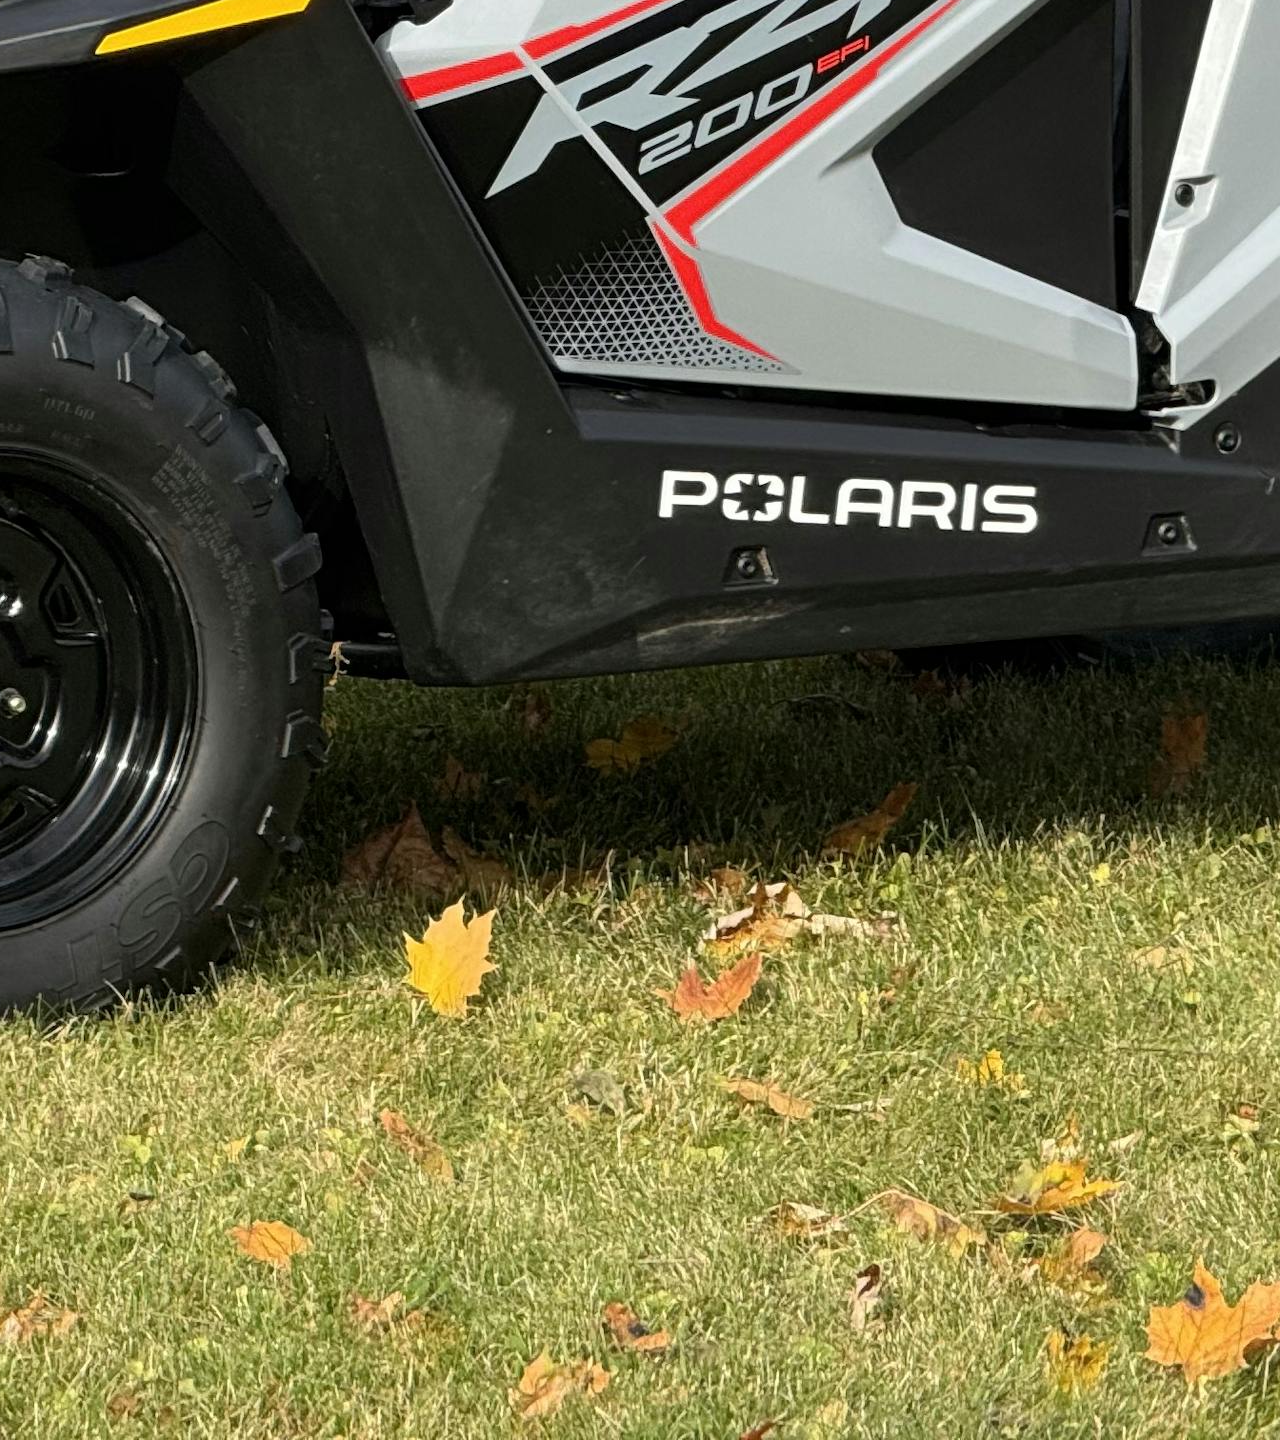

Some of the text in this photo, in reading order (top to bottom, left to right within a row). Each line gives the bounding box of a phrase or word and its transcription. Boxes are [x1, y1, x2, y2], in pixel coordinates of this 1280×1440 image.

[638, 35, 870, 176] 200 EFI
[658, 470, 1039, 534] POLARIS
